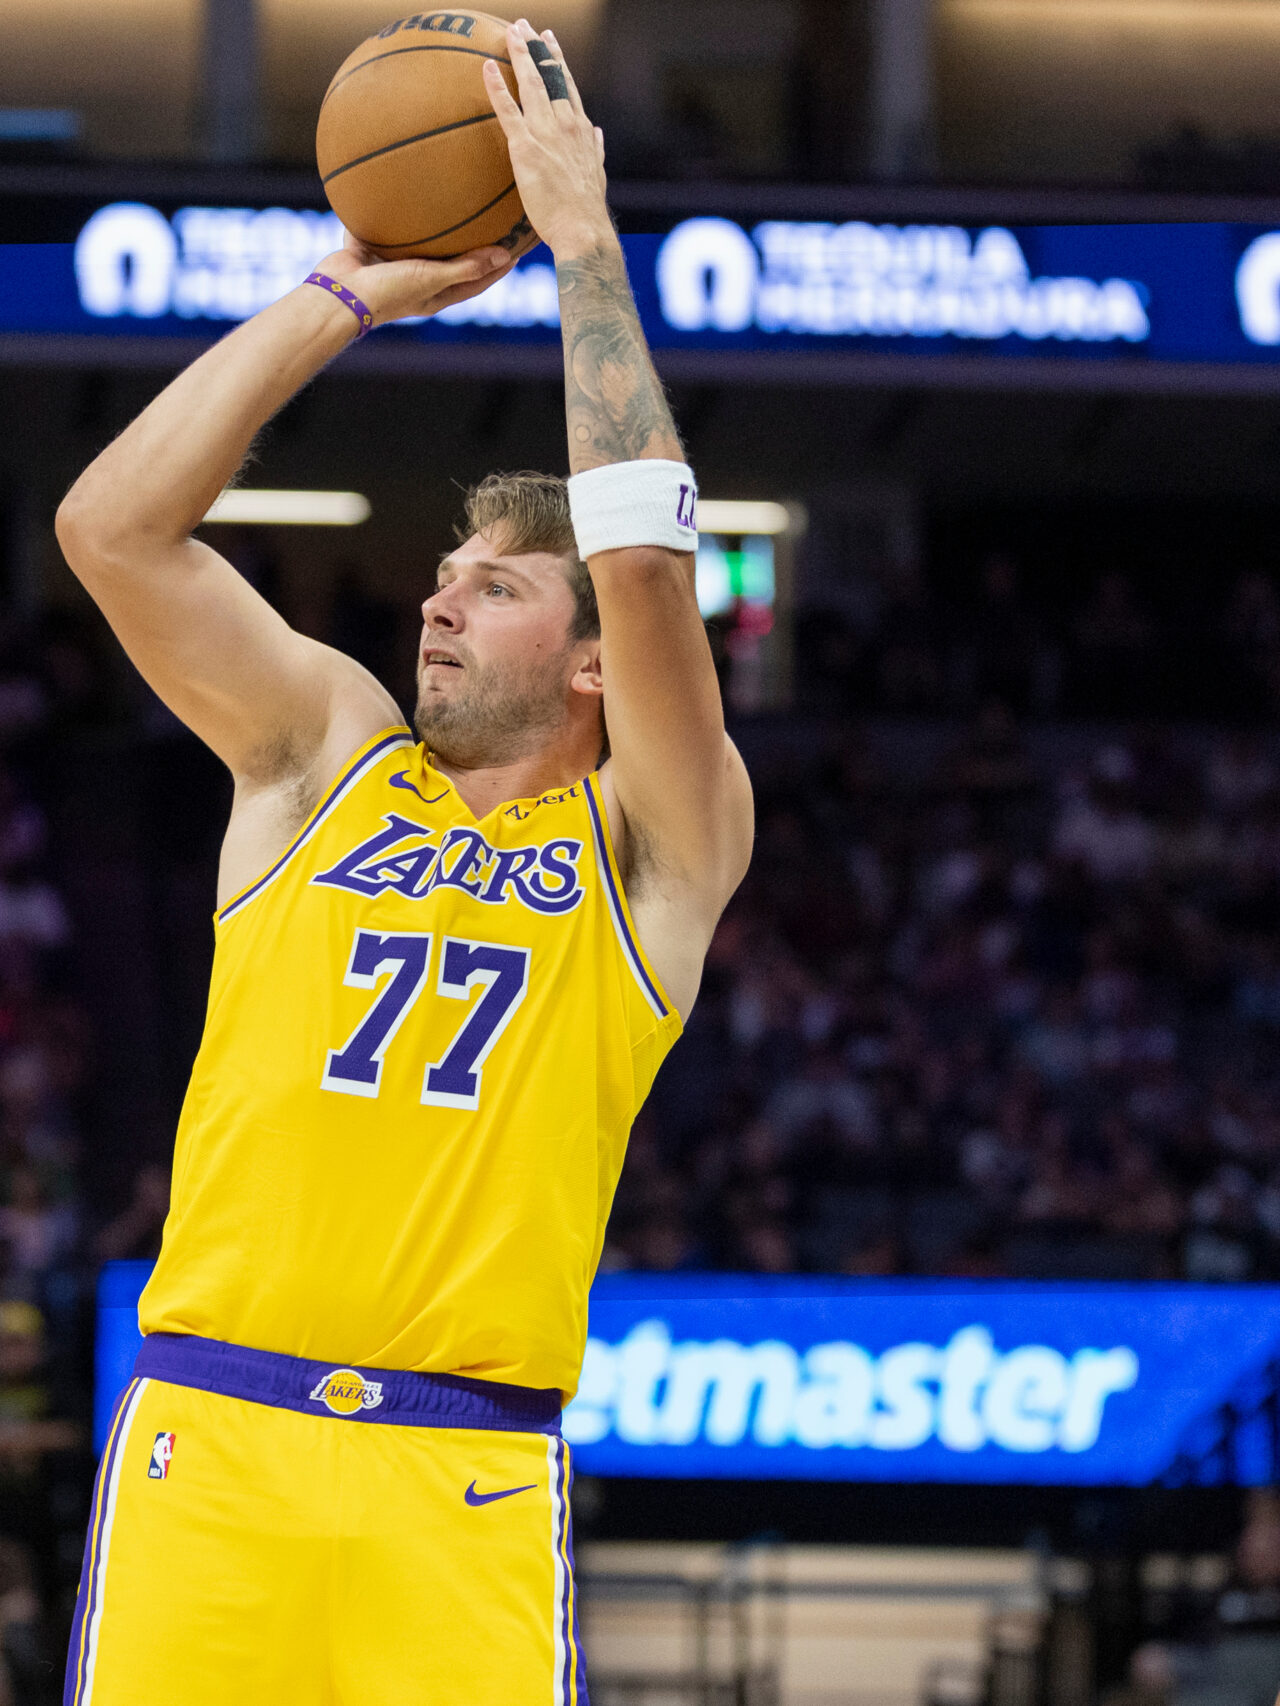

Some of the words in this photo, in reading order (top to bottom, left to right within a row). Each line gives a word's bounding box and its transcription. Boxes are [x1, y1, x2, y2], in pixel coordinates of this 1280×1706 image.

[504, 786, 580, 820] Aert
[308, 812, 587, 916] LAERS
[320, 927, 532, 1111] 77
[311, 1377, 382, 1408] LAKERS
